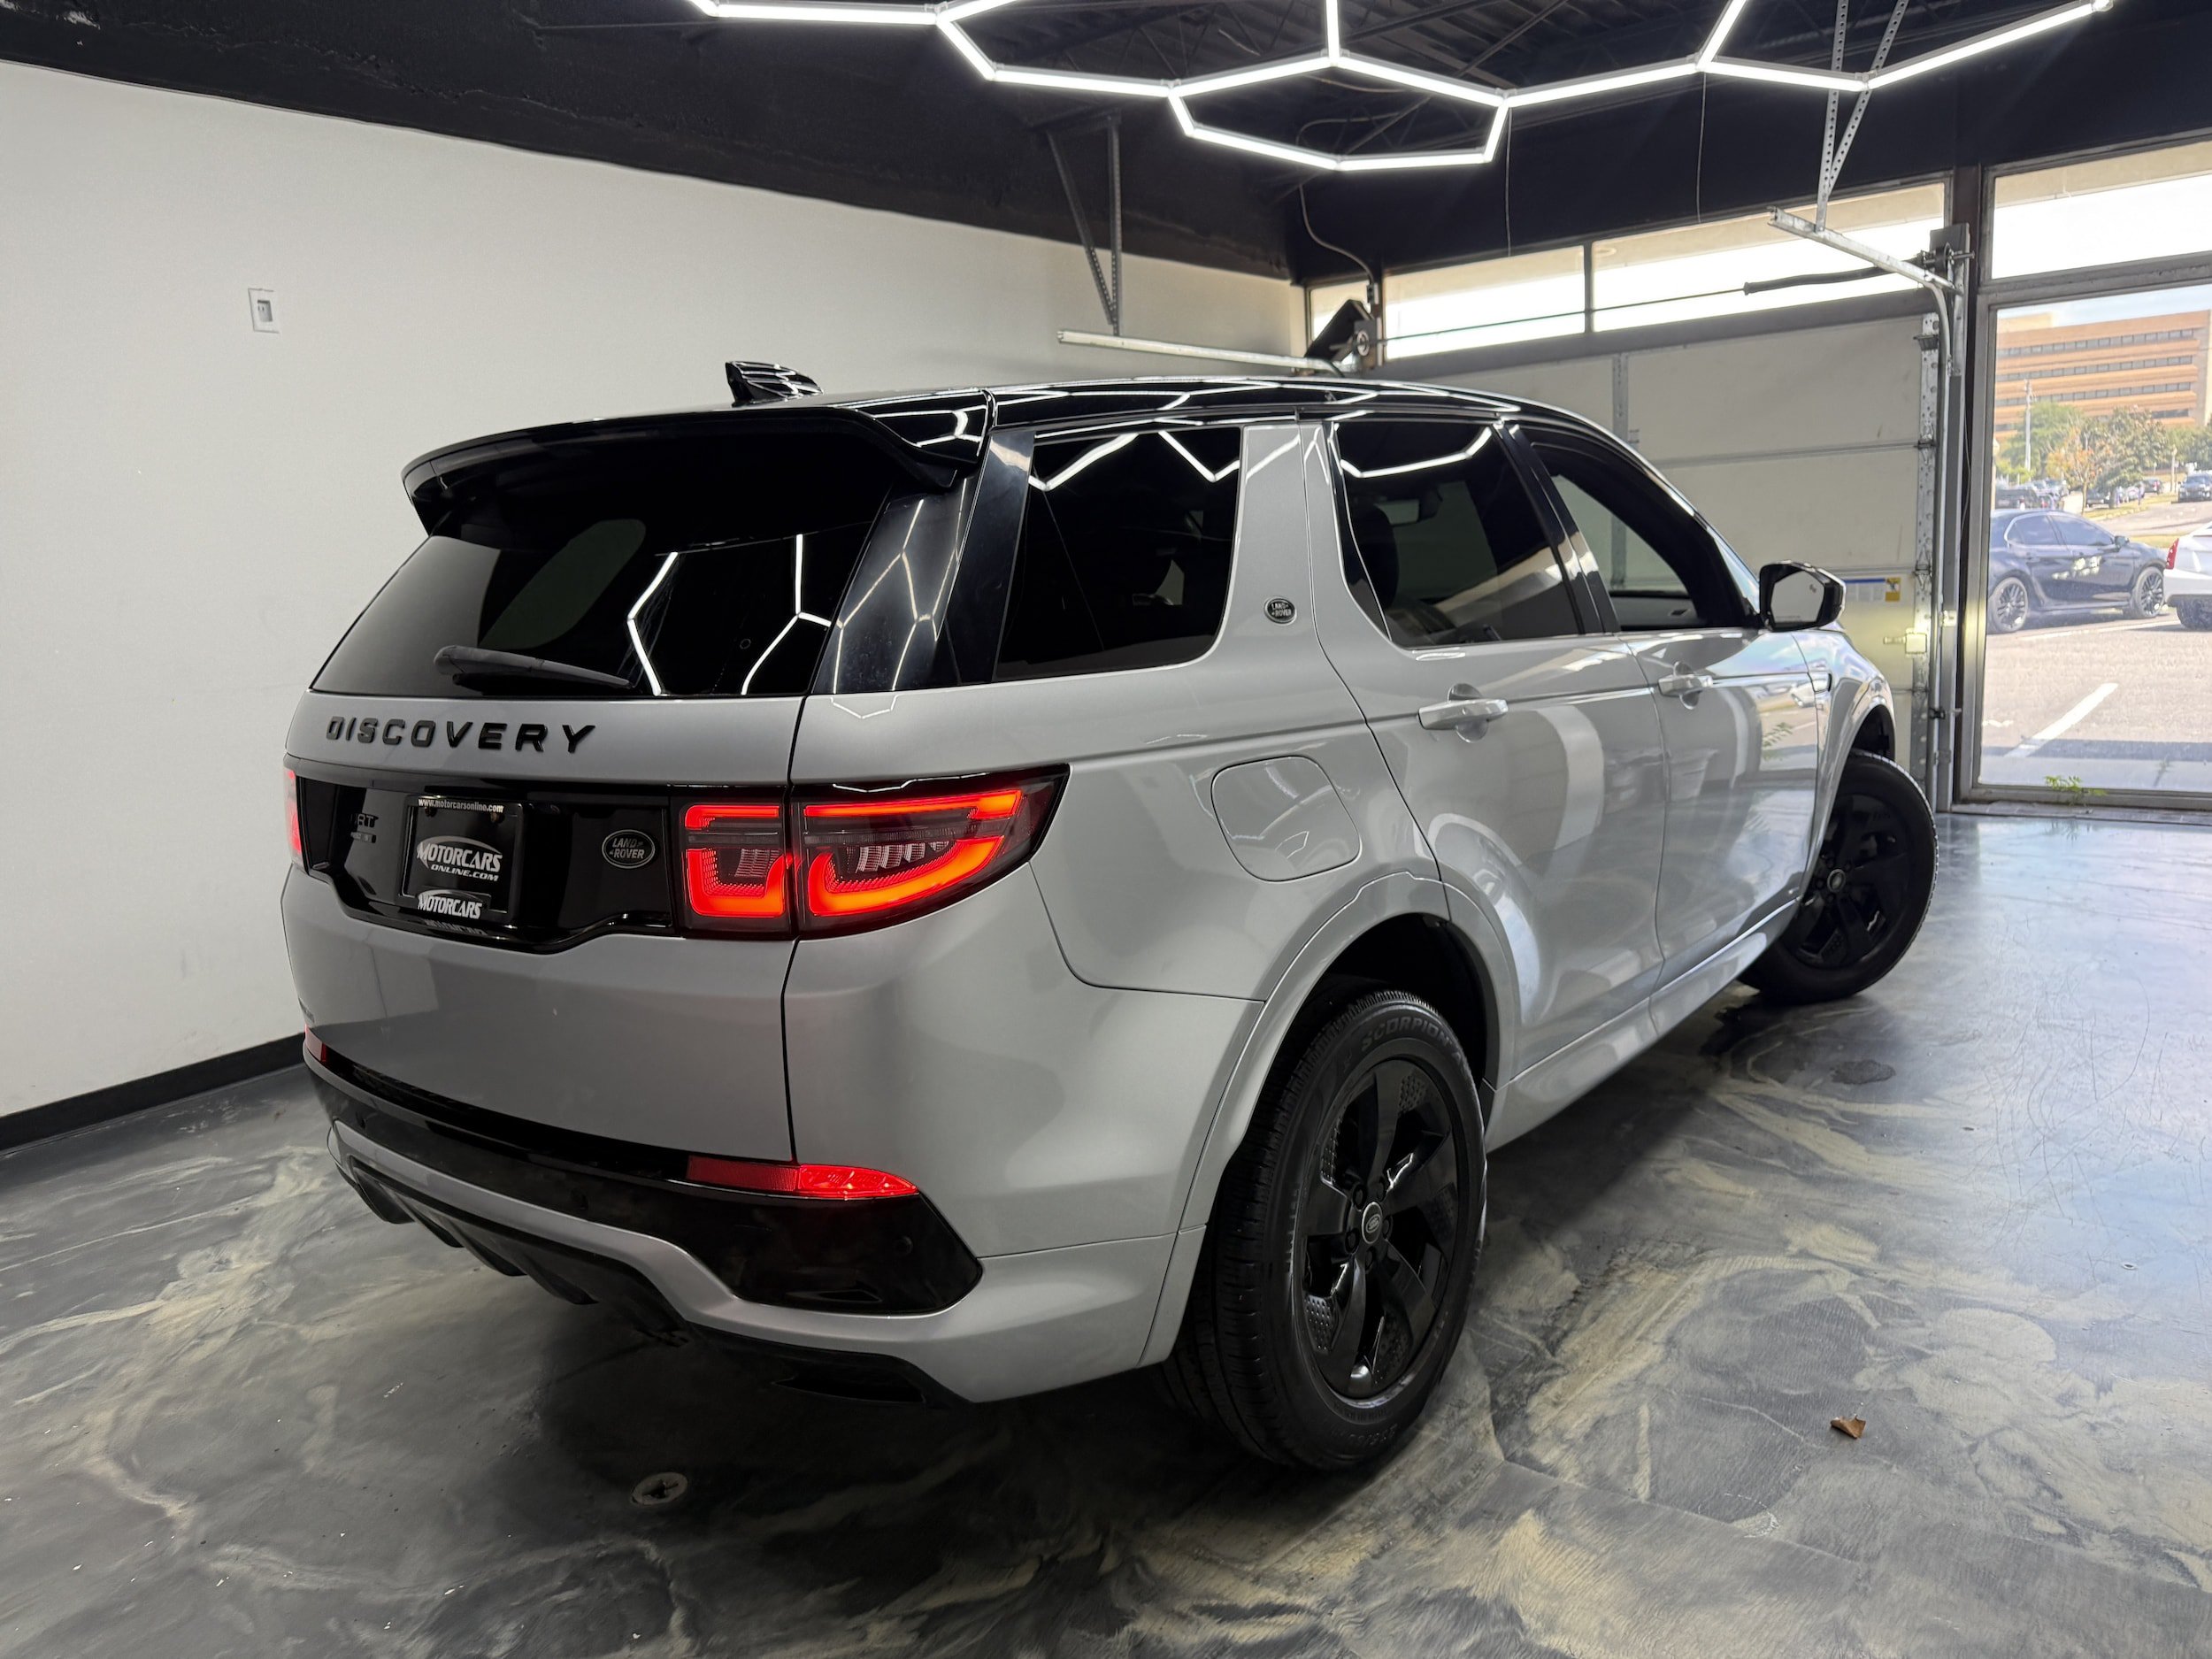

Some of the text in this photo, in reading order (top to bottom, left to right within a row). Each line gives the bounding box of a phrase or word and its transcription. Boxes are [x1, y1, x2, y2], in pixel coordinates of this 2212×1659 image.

[326, 716, 595, 753] DISCOVERY
[418, 798, 504, 813] www.motorcarsonline.com
[612, 837, 637, 849] LAND
[613, 848, 645, 859] ROVER
[417, 841, 503, 872] MOTORCARS
[431, 864, 499, 881] ONLINE.COM
[418, 894, 483, 919] MOTORCARS
[1361, 1016, 1453, 1052] SCORPION
